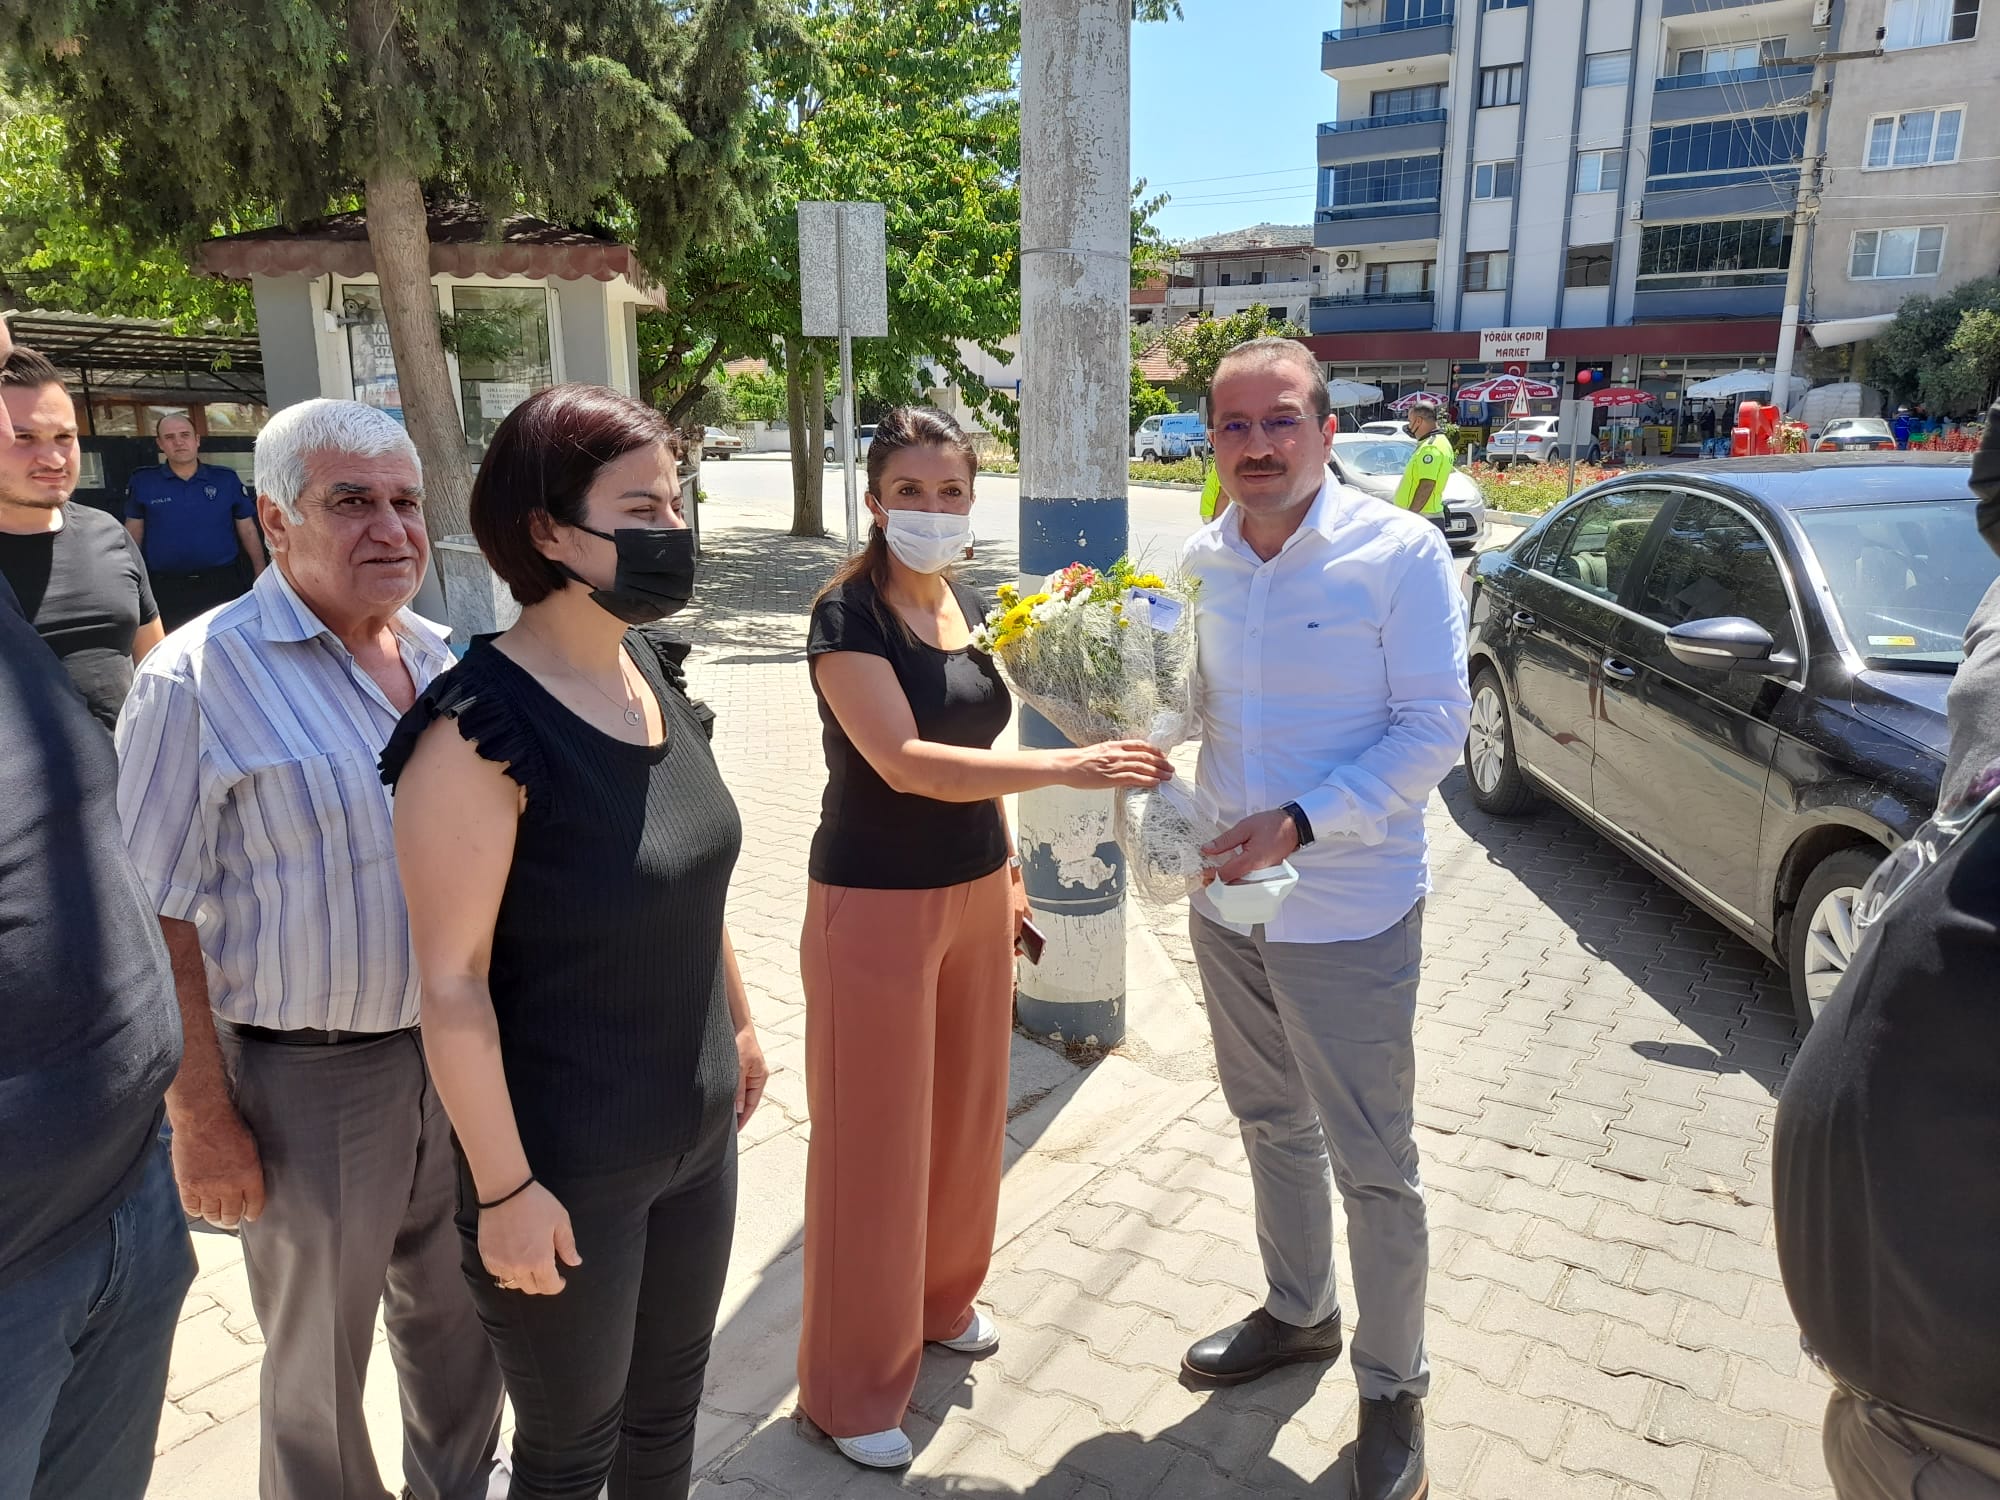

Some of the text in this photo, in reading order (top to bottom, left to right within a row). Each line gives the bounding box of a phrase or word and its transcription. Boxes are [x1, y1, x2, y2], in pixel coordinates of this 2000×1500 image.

[1484, 331, 1544, 343] YÖRÜK ÇADIRI
[1495, 347, 1530, 358] MARKET
